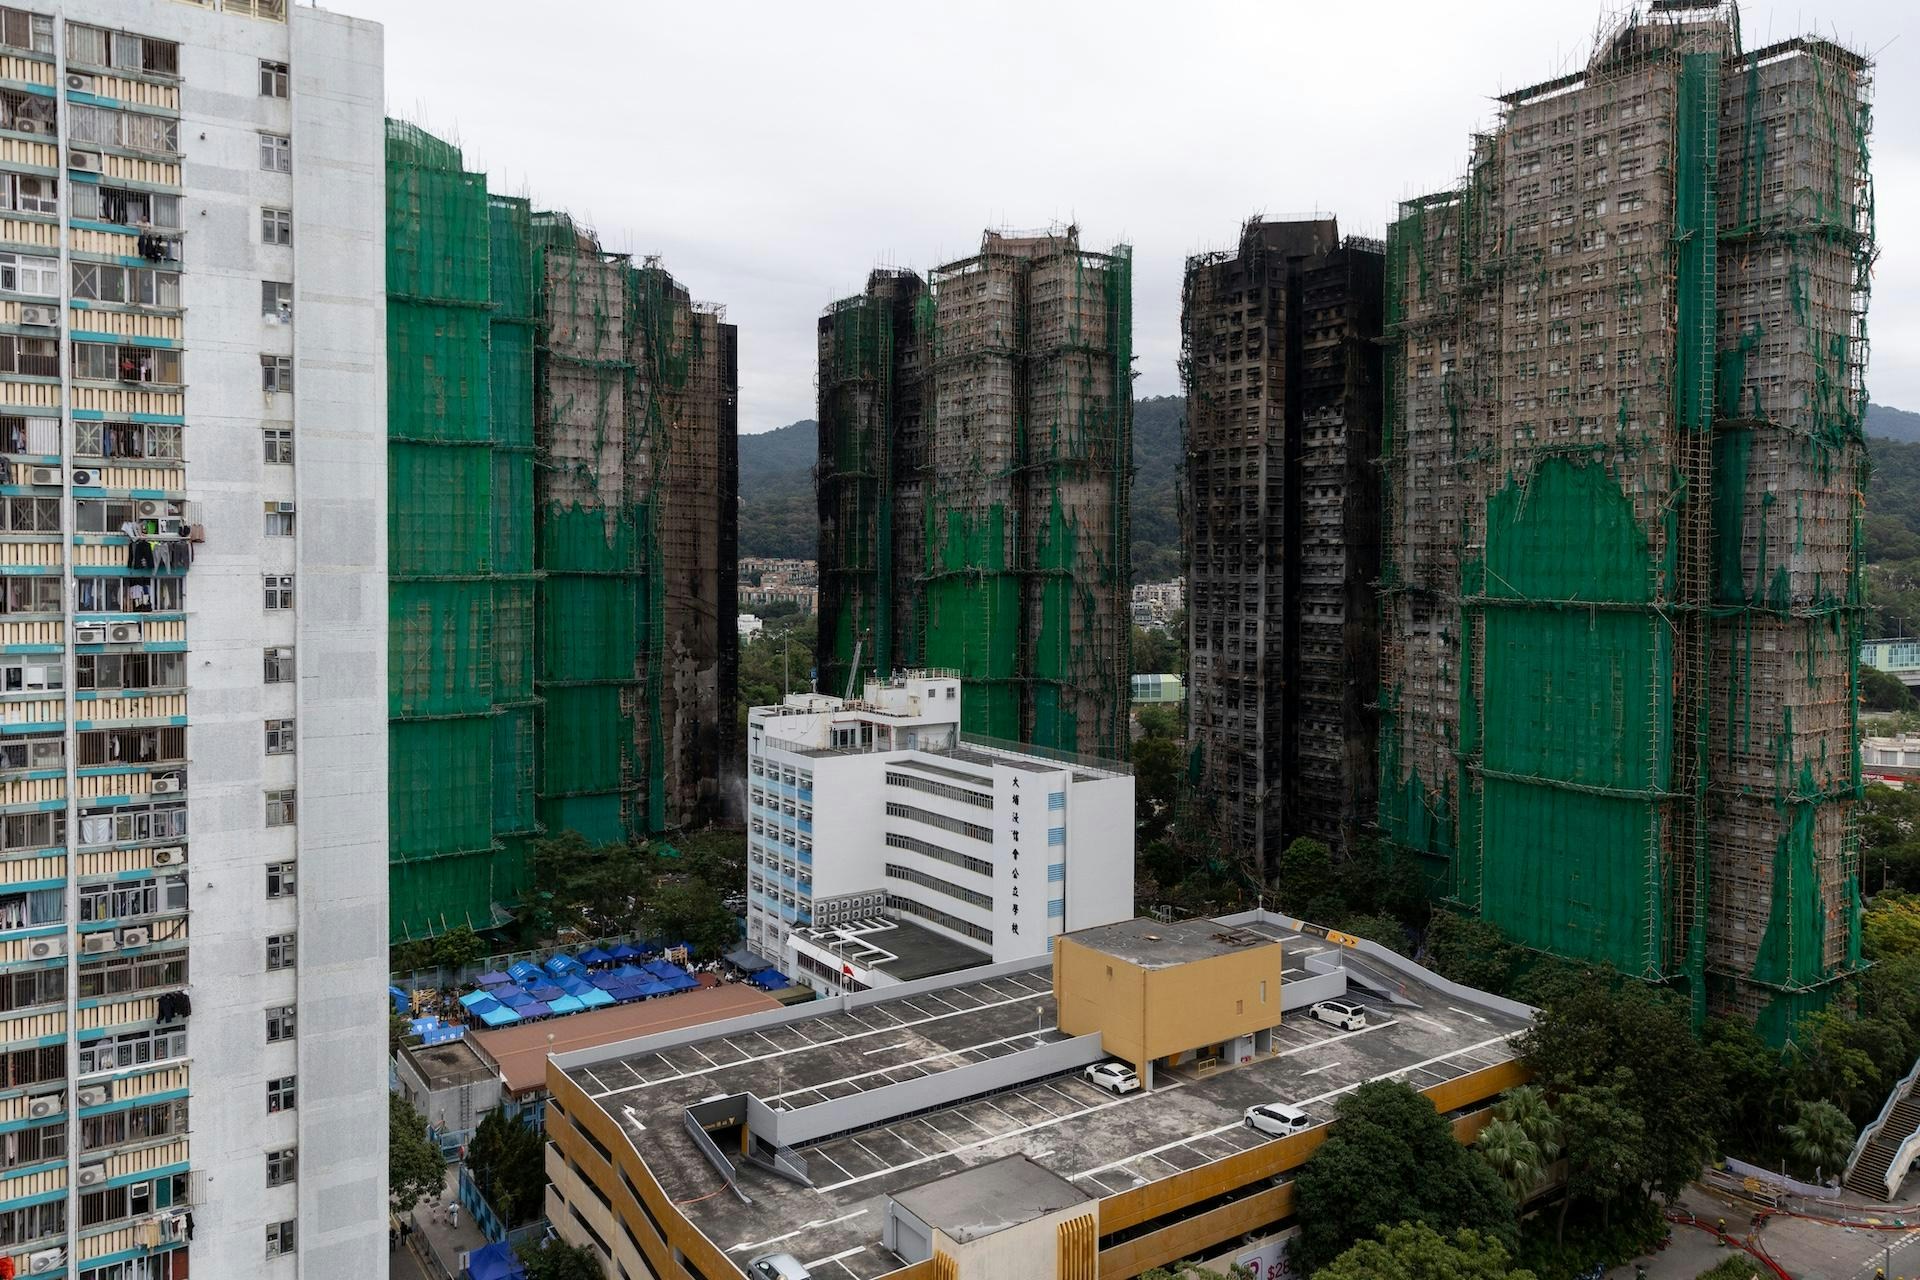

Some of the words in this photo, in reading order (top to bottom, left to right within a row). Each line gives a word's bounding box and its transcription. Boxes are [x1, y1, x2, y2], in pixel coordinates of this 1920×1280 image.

[1011, 776, 1020, 936] 大埔浸信會公立學校
